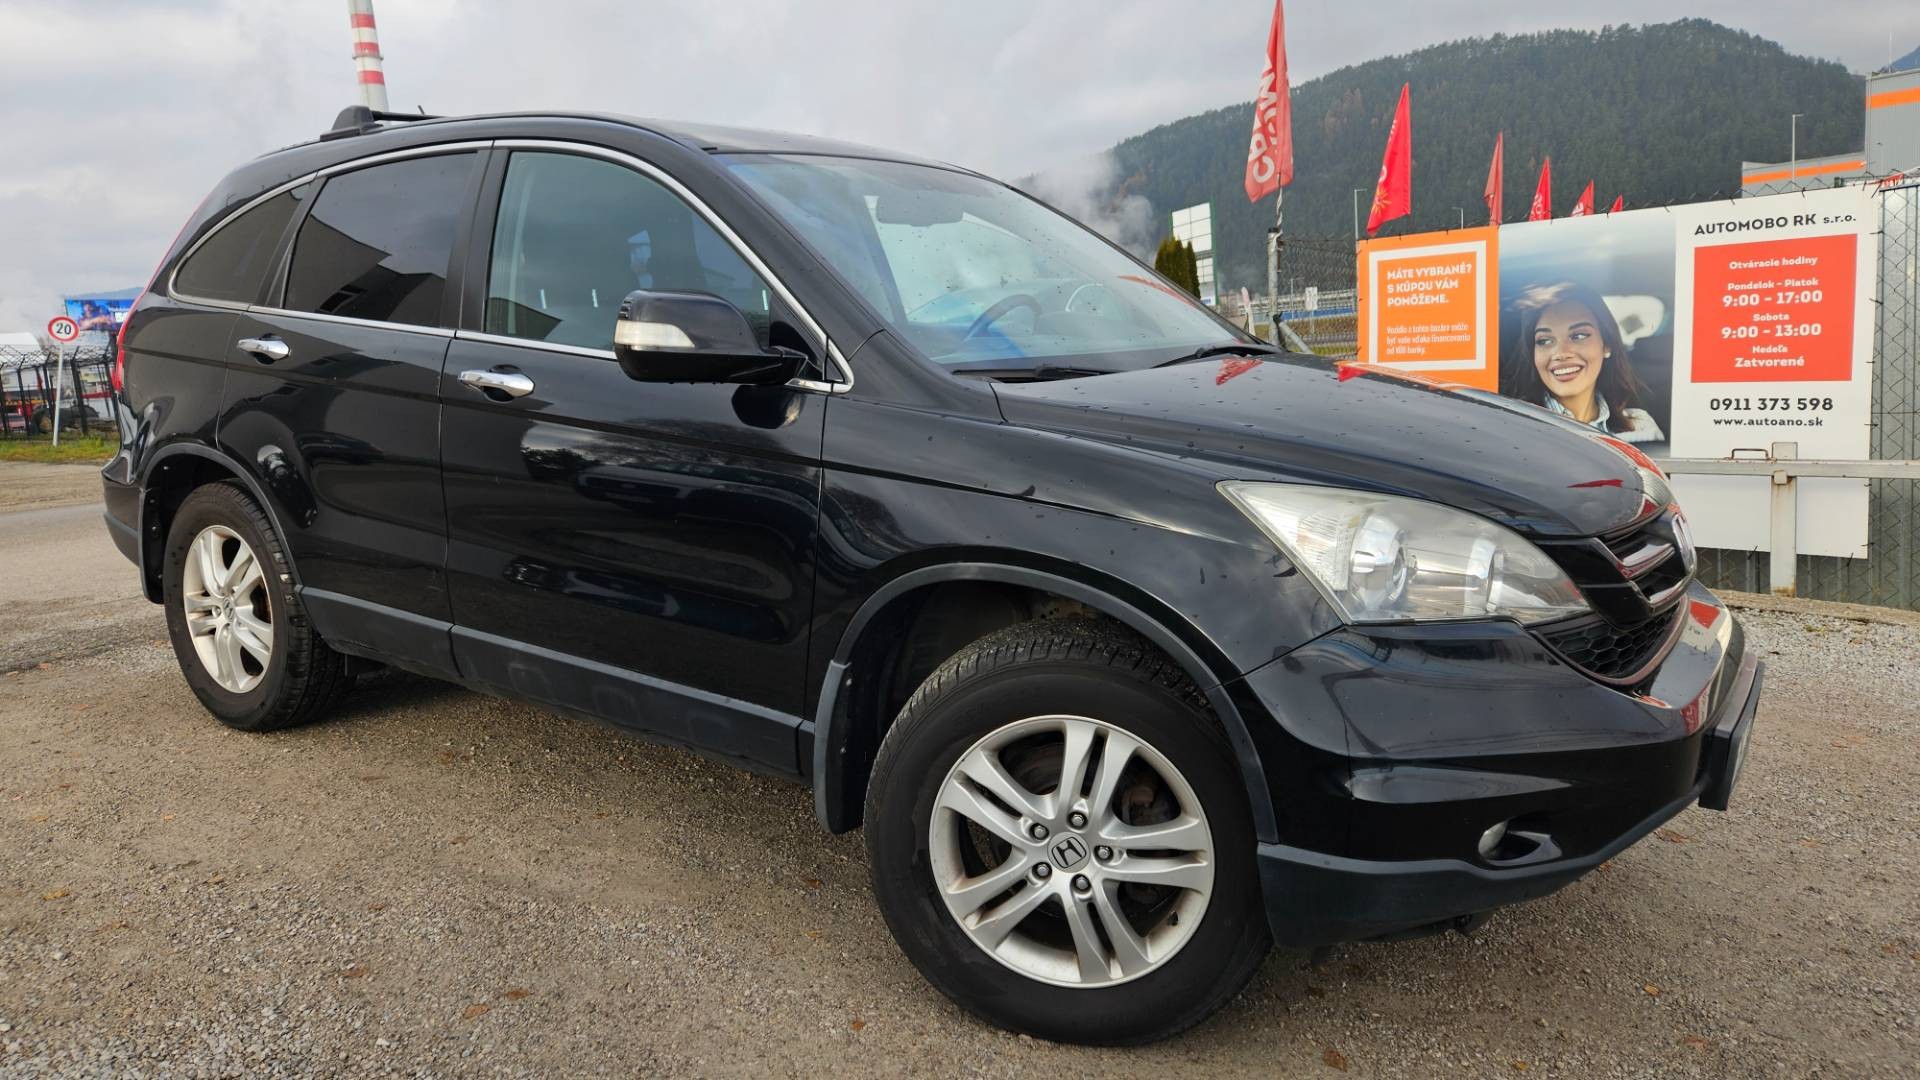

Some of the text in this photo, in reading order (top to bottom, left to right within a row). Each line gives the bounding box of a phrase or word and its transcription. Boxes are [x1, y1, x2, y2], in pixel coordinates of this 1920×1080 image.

[1694, 214, 1857, 235] AUTOMOBO RK s.r.o.
[1729, 256, 1818, 270] Otváracie hodiny
[1387, 261, 1472, 280] MÁTE VYBRANÉ?
[1387, 277, 1459, 293] S KÚPOU VÁM
[1727, 280, 1774, 291] Pondelok
[1784, 277, 1819, 288] Piatok
[1722, 294, 1760, 307] 9:00
[1776, 290, 1823, 304] 17:00
[1753, 313, 1790, 322] Sobota
[56, 323, 72, 335] 20
[1721, 326, 1759, 339] 9:00
[1775, 323, 1822, 337] 13:00
[1752, 344, 1788, 353] Nedeľa
[1734, 356, 1805, 368] Zatvorené
[1710, 398, 1833, 411] 0911 373 598
[1713, 417, 1823, 426] www.autoano.sk
